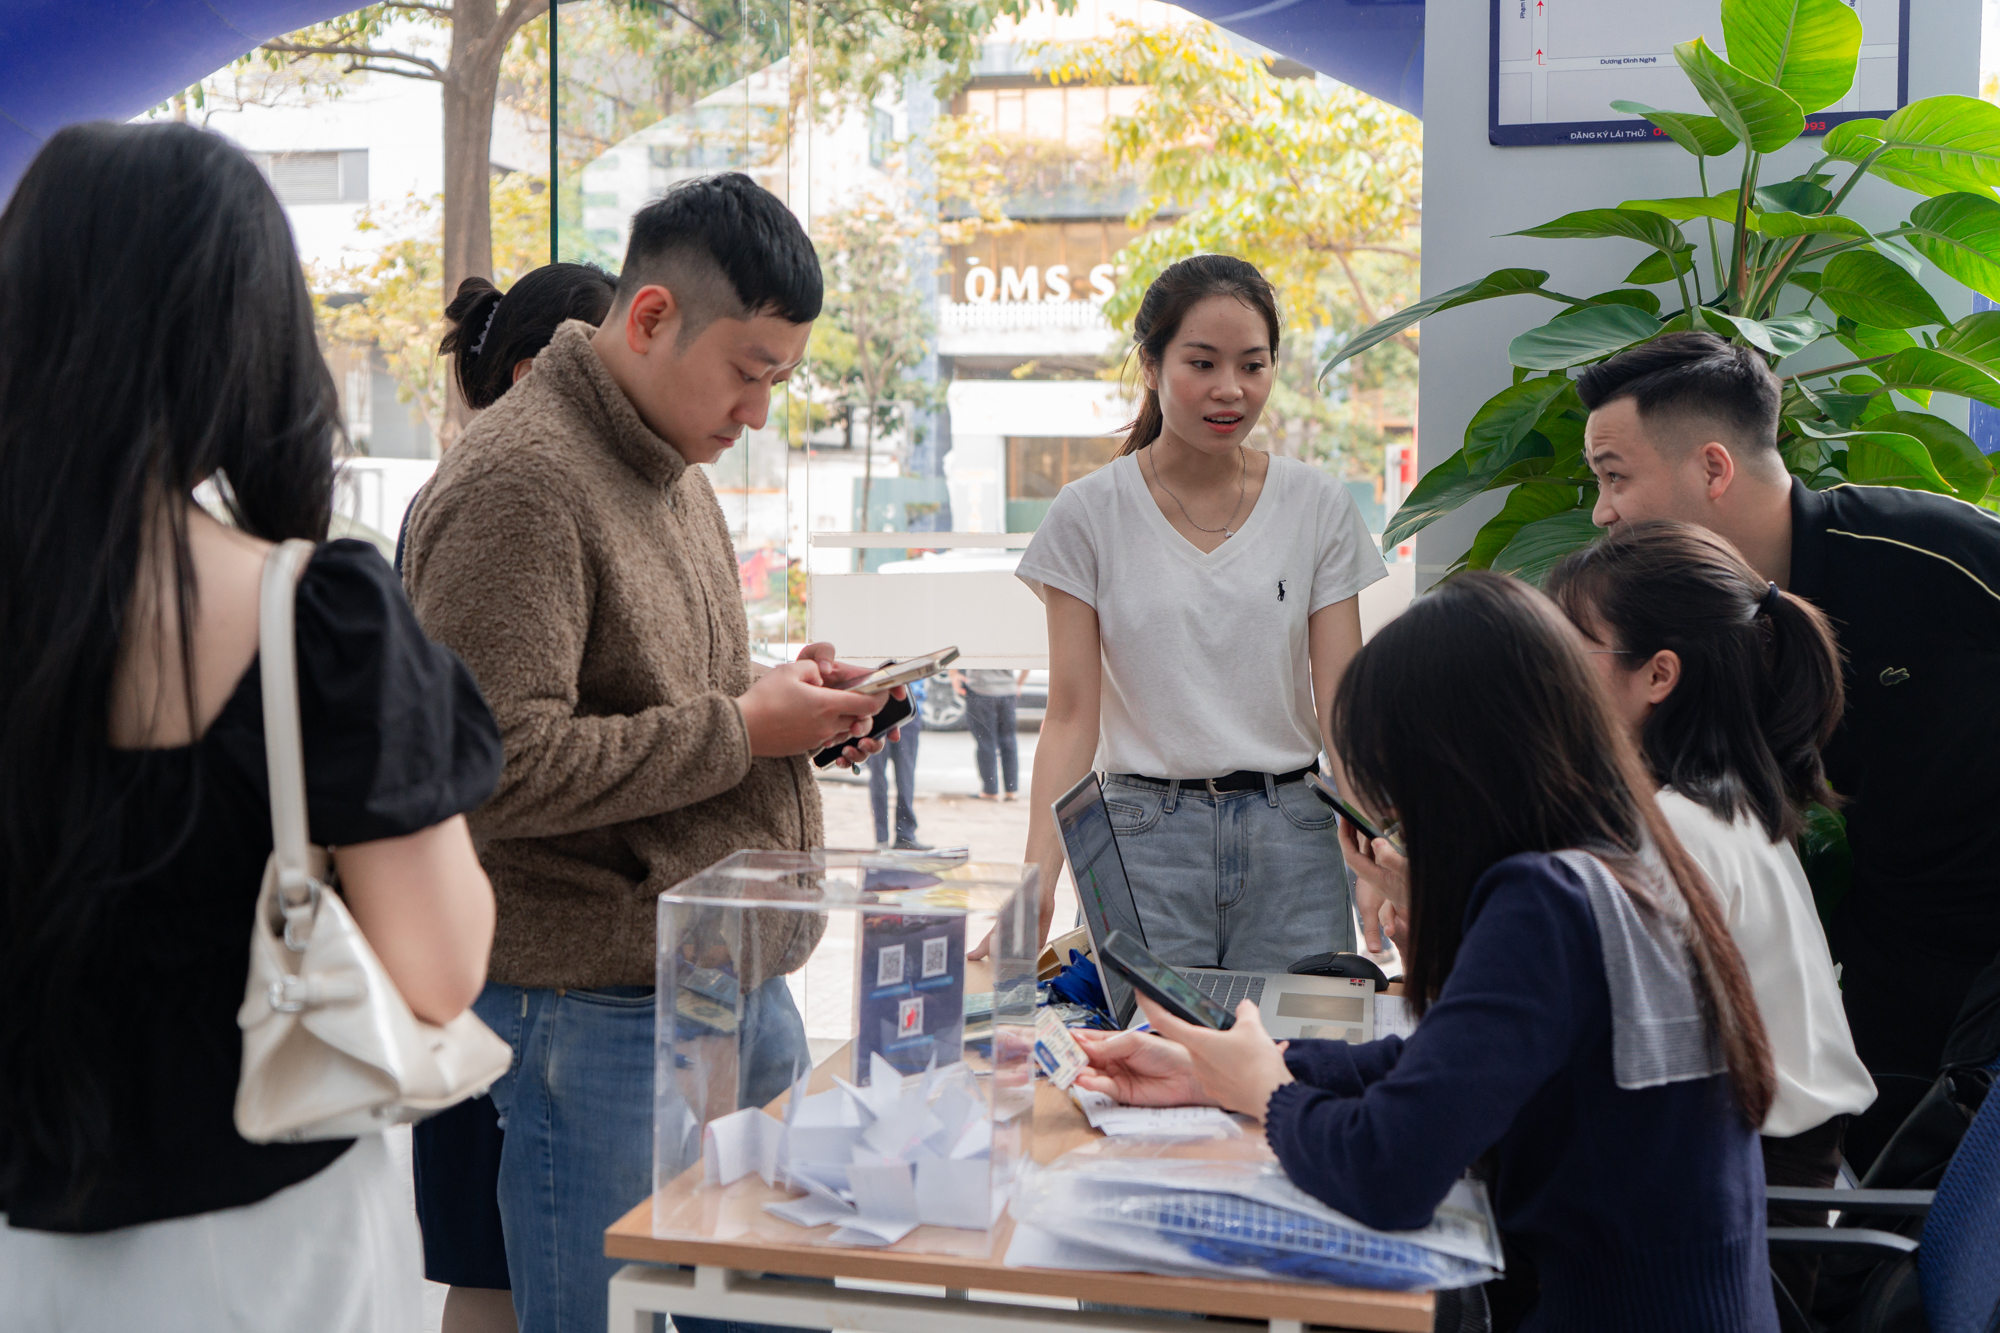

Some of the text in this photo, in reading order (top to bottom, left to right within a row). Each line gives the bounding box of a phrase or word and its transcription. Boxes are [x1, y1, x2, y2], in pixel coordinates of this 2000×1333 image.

[1570, 130, 1596, 139] ĐĂNG
[1596, 129, 1609, 138] KÝ
[1610, 129, 1624, 138] LÁI
[1625, 128, 1647, 138] THỬ:
